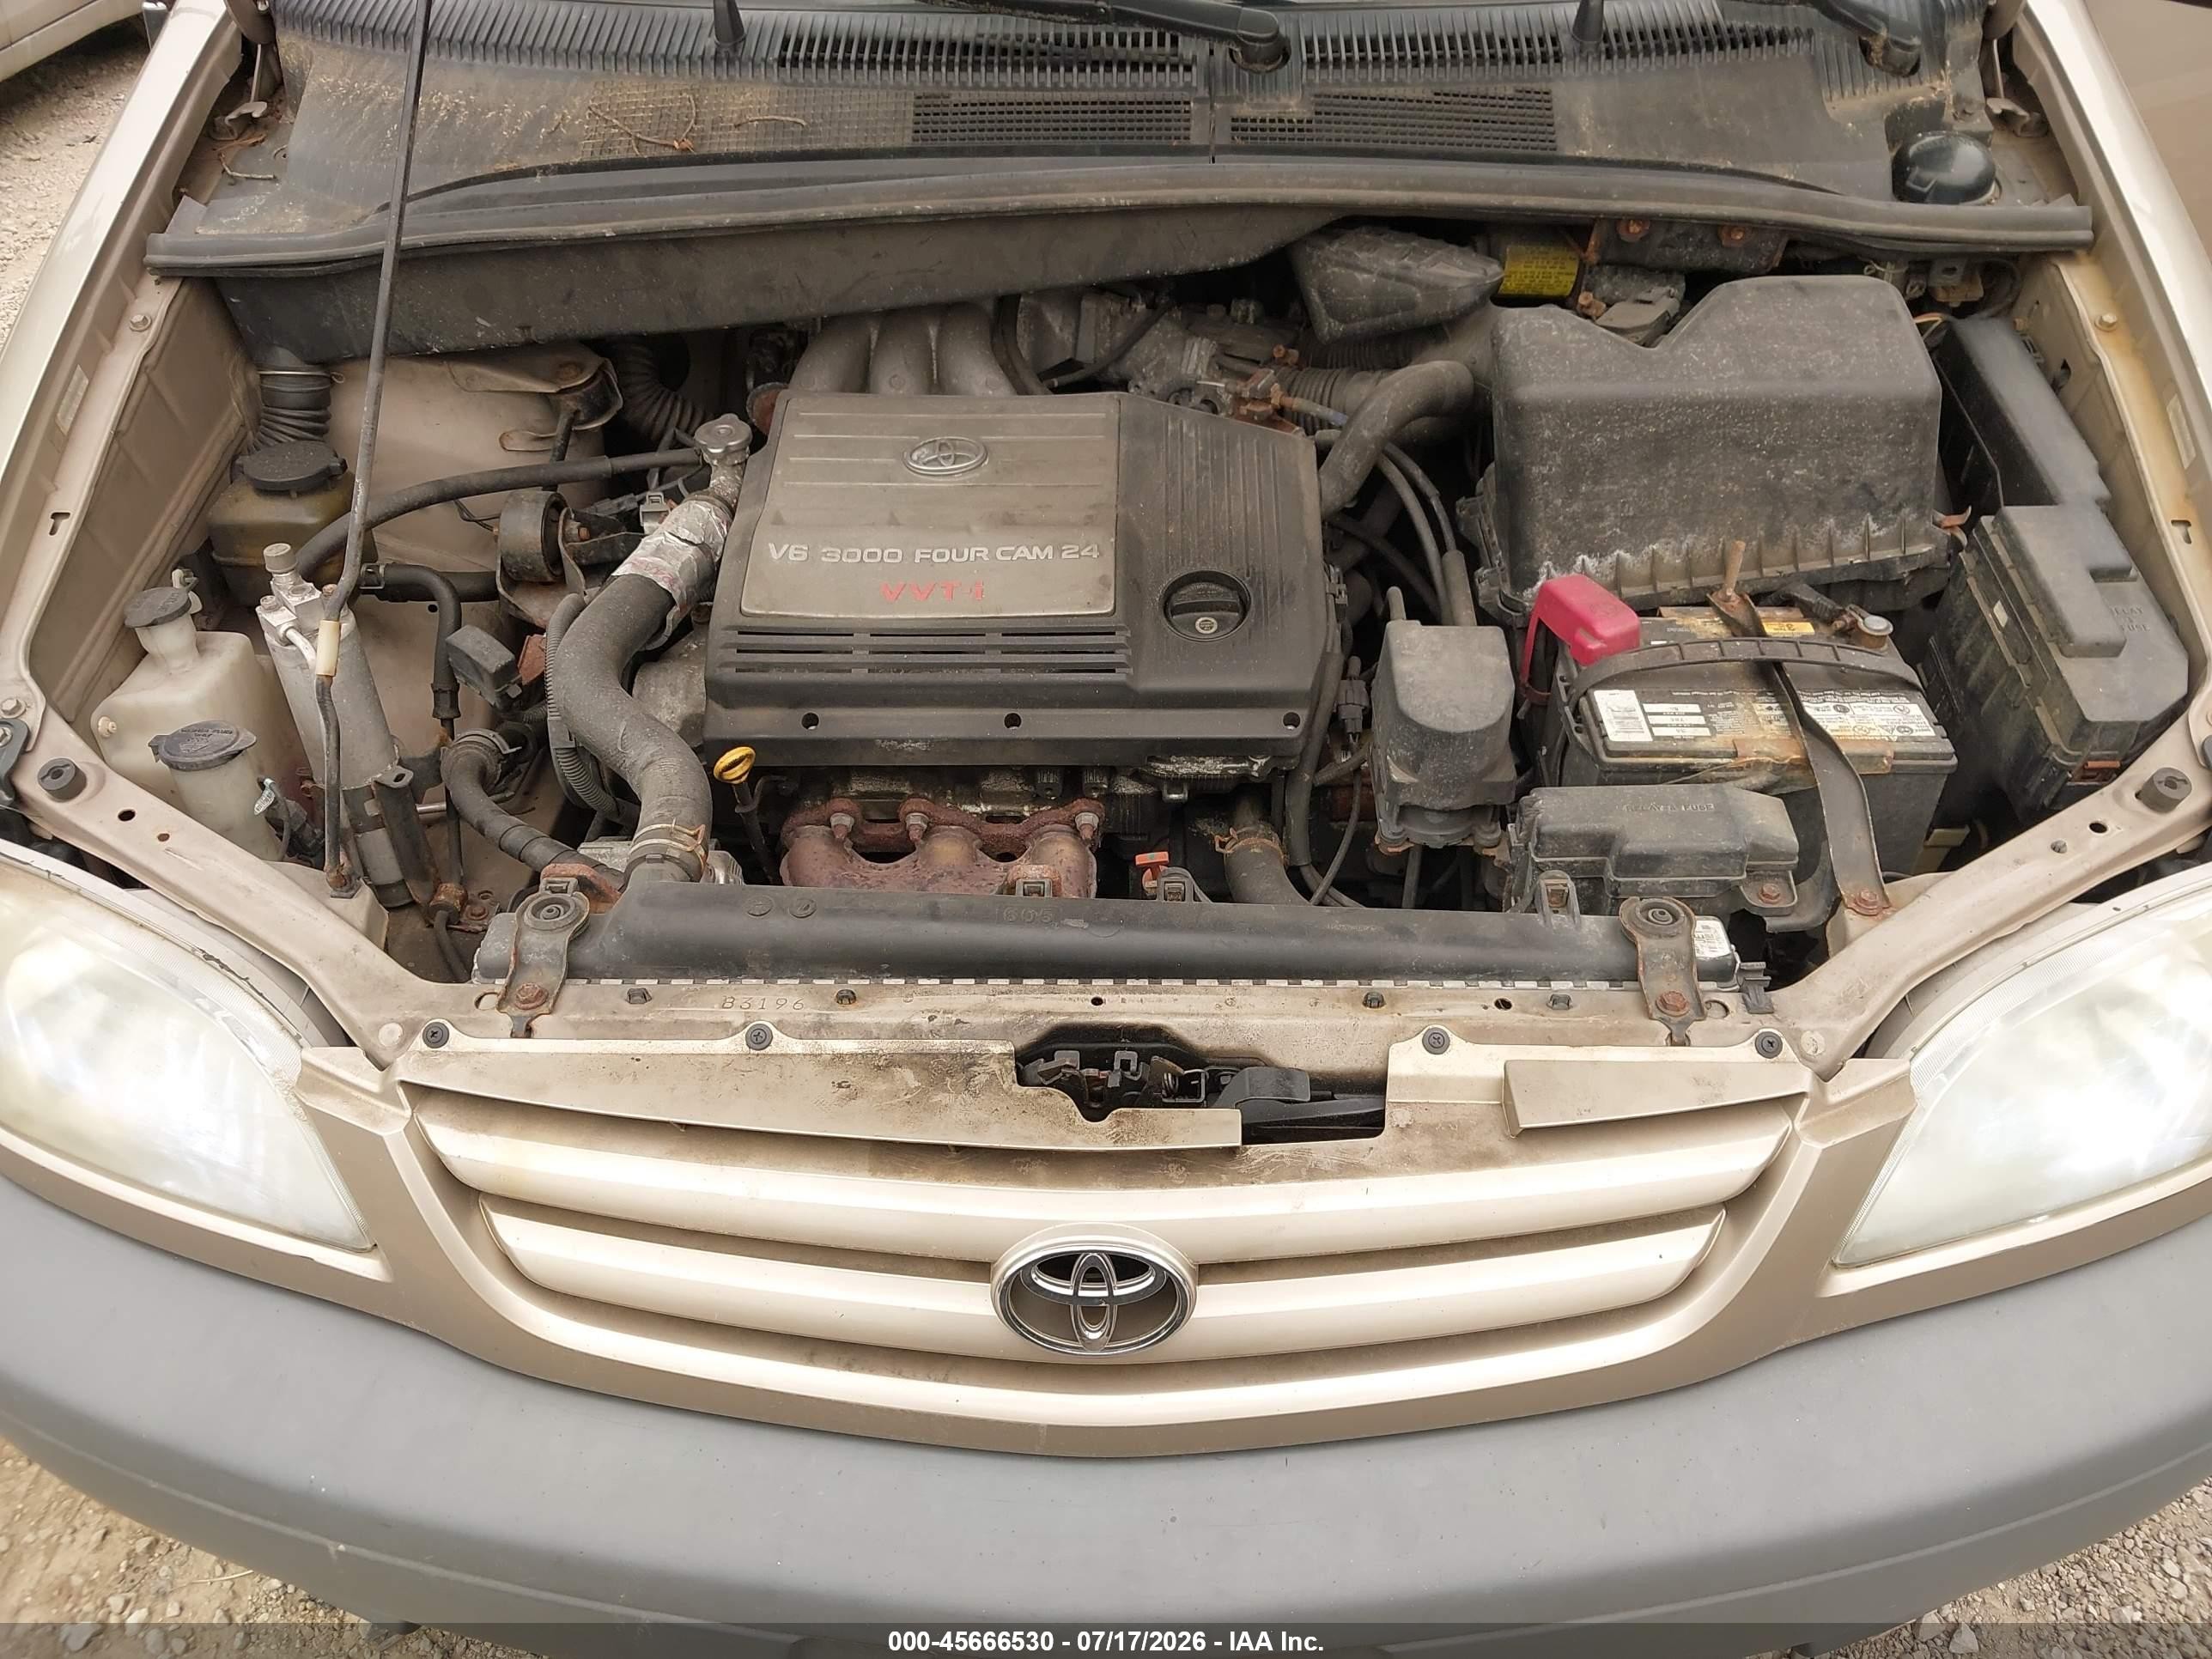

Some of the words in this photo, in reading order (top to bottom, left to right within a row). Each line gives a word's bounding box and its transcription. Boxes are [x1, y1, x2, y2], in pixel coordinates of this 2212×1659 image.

[768, 543, 809, 562] V6
[820, 546, 904, 563] 3000
[914, 545, 990, 563] FOUR
[995, 544, 1054, 561] CAM
[1060, 544, 1100, 559] 24
[1680, 802, 1716, 812] FUSE
